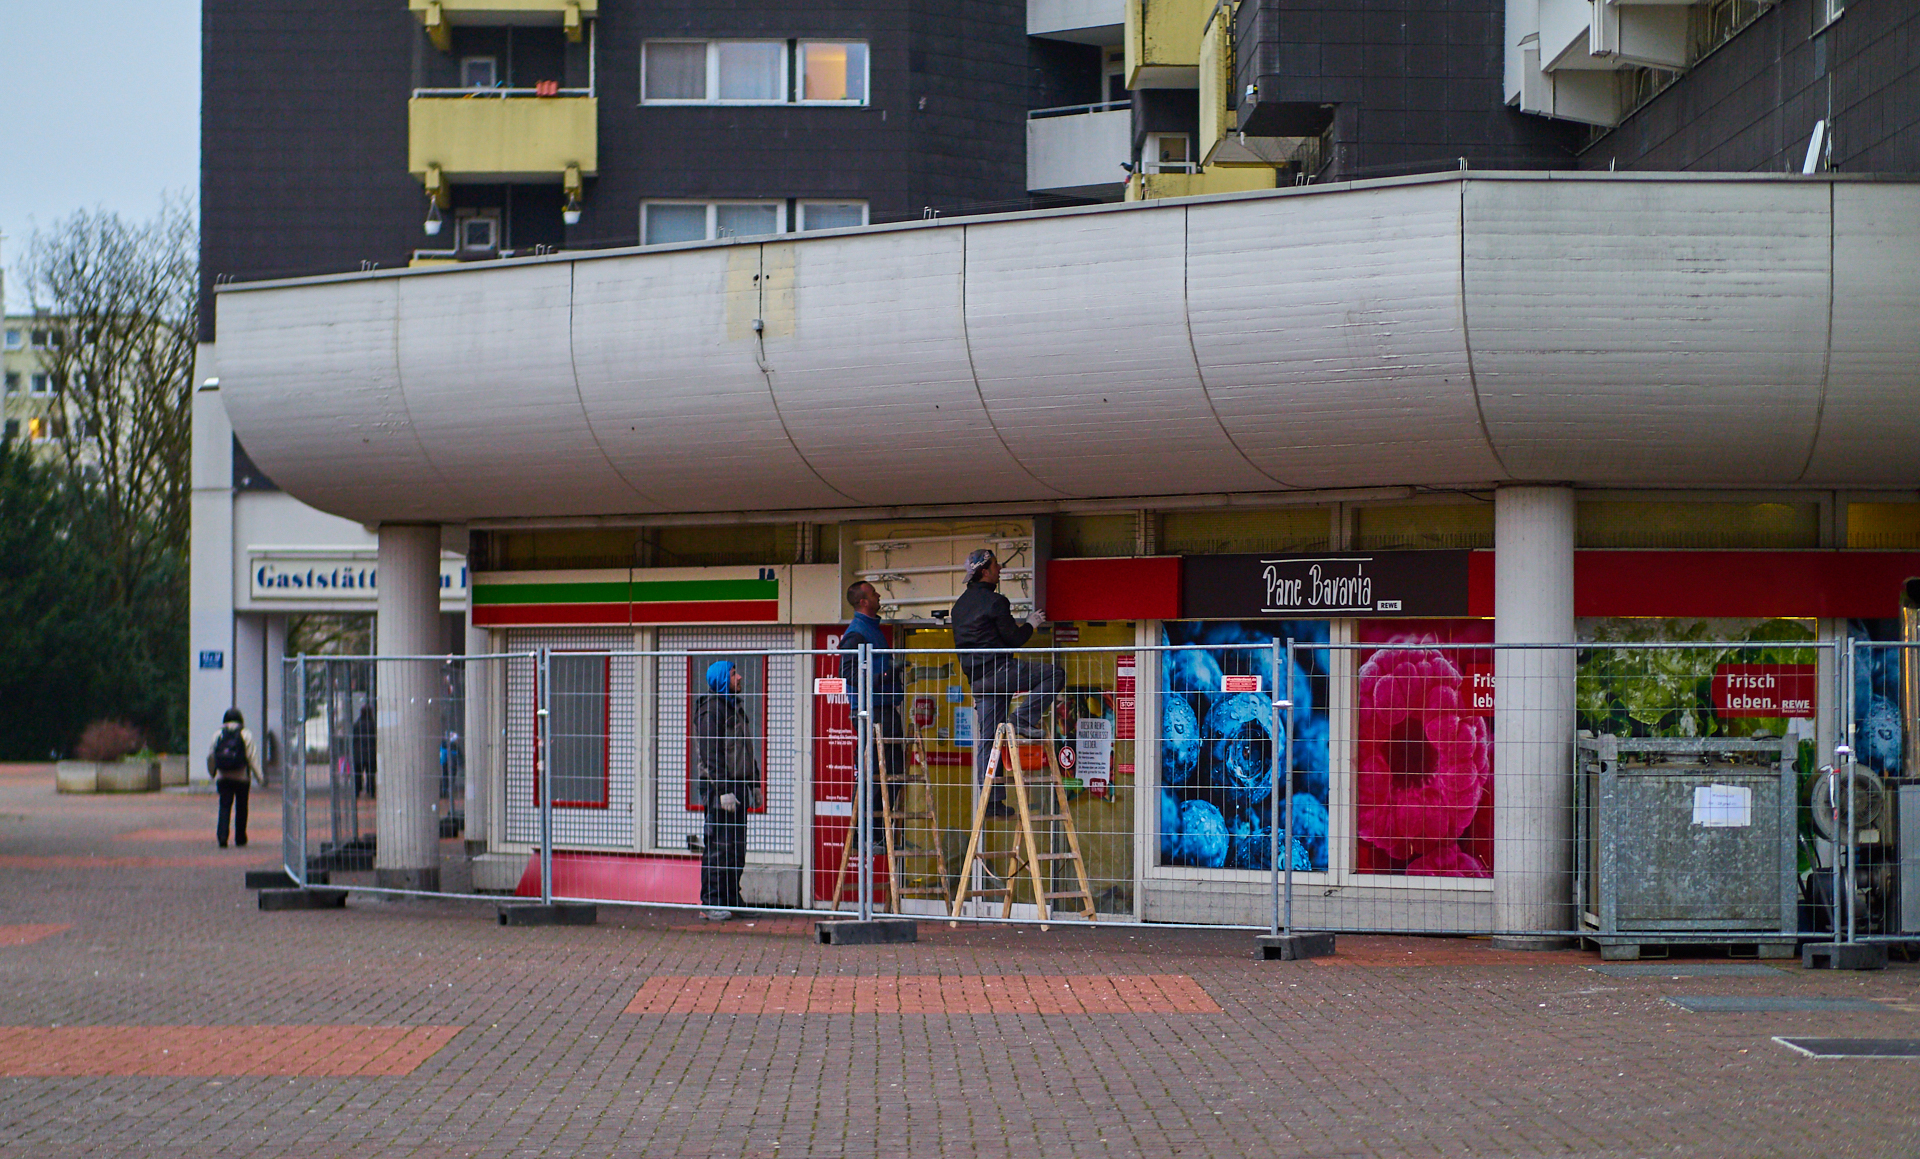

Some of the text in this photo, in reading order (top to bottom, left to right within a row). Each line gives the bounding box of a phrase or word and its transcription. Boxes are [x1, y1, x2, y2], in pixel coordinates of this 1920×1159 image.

[257, 565, 378, 588] Gaststätt
[1262, 563, 1371, 606] Pane Bavaria
[1473, 673, 1495, 688] Fris
[1727, 673, 1775, 688] Frisch
[826, 693, 850, 704] Willk
[1473, 692, 1495, 708] leb
[1727, 693, 1777, 709] leben.
[1781, 700, 1810, 709] REWE
